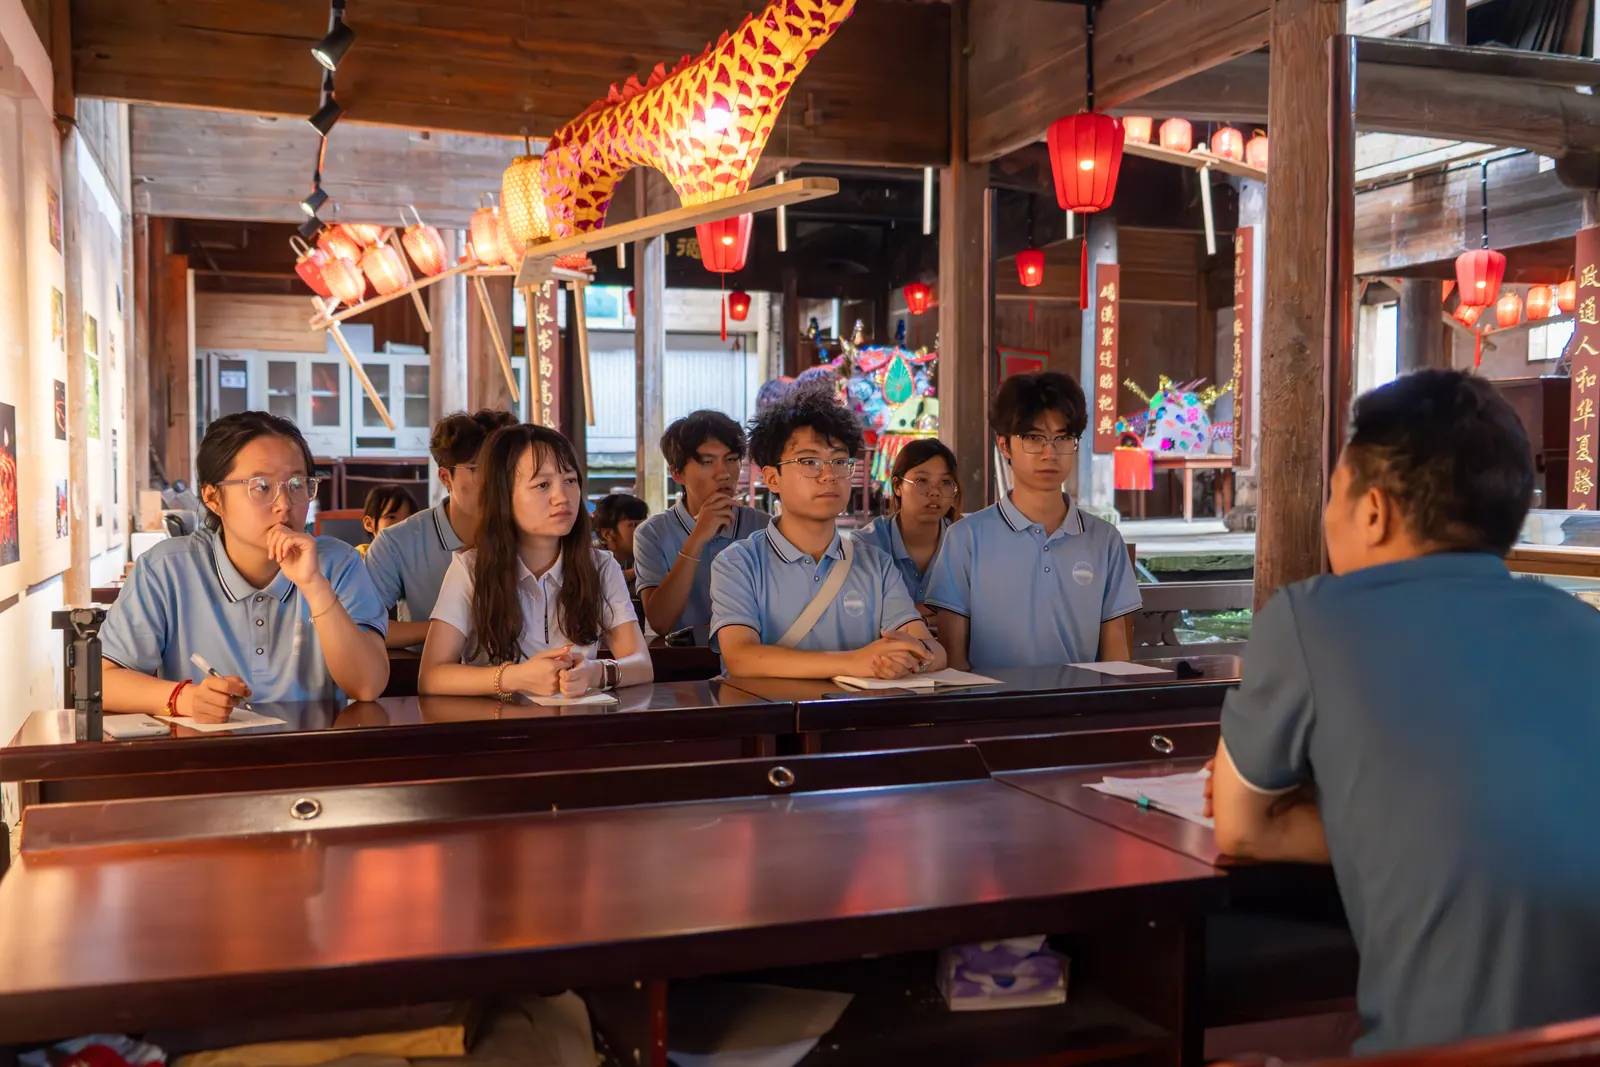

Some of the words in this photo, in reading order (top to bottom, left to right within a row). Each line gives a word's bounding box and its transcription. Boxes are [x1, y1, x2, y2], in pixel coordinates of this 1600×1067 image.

[1572, 263, 1600, 511] 政通人和华夏腾
